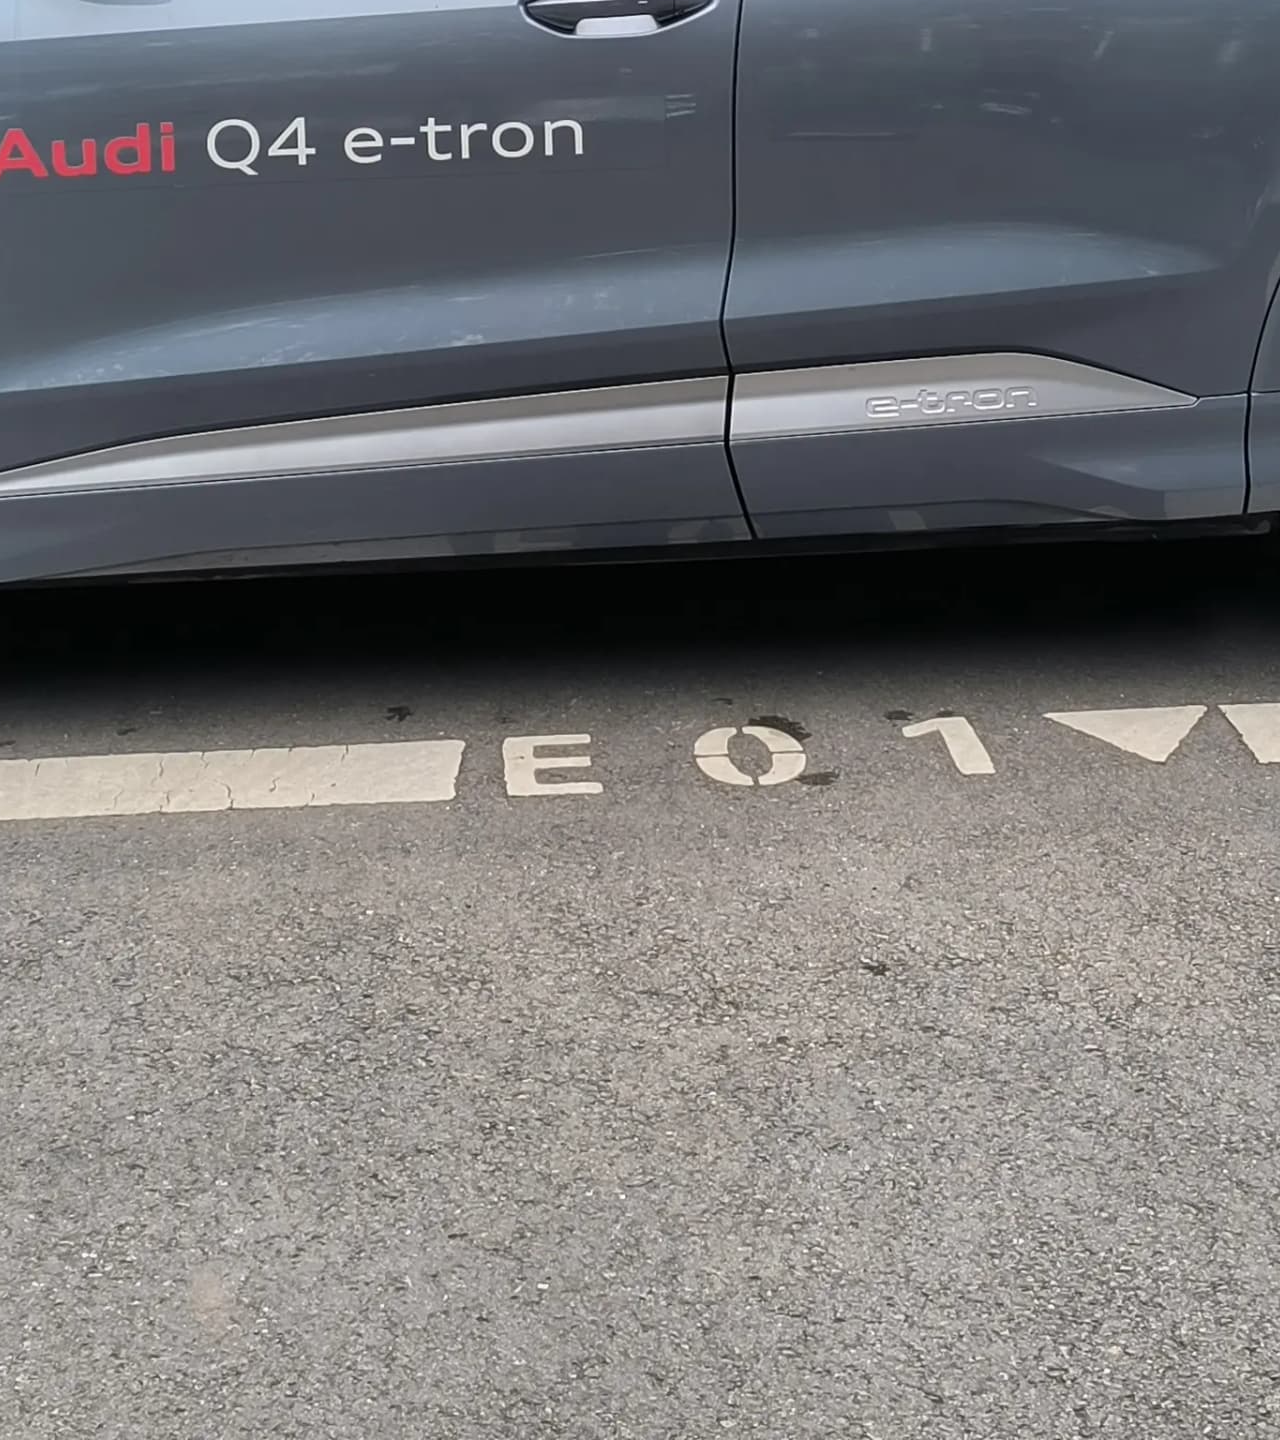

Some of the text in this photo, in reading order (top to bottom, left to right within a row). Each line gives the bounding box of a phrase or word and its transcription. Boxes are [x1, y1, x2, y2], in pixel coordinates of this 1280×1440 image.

[206, 116, 317, 175] Q4
[343, 116, 585, 164] e-tron
[865, 386, 1039, 418] e-tron
